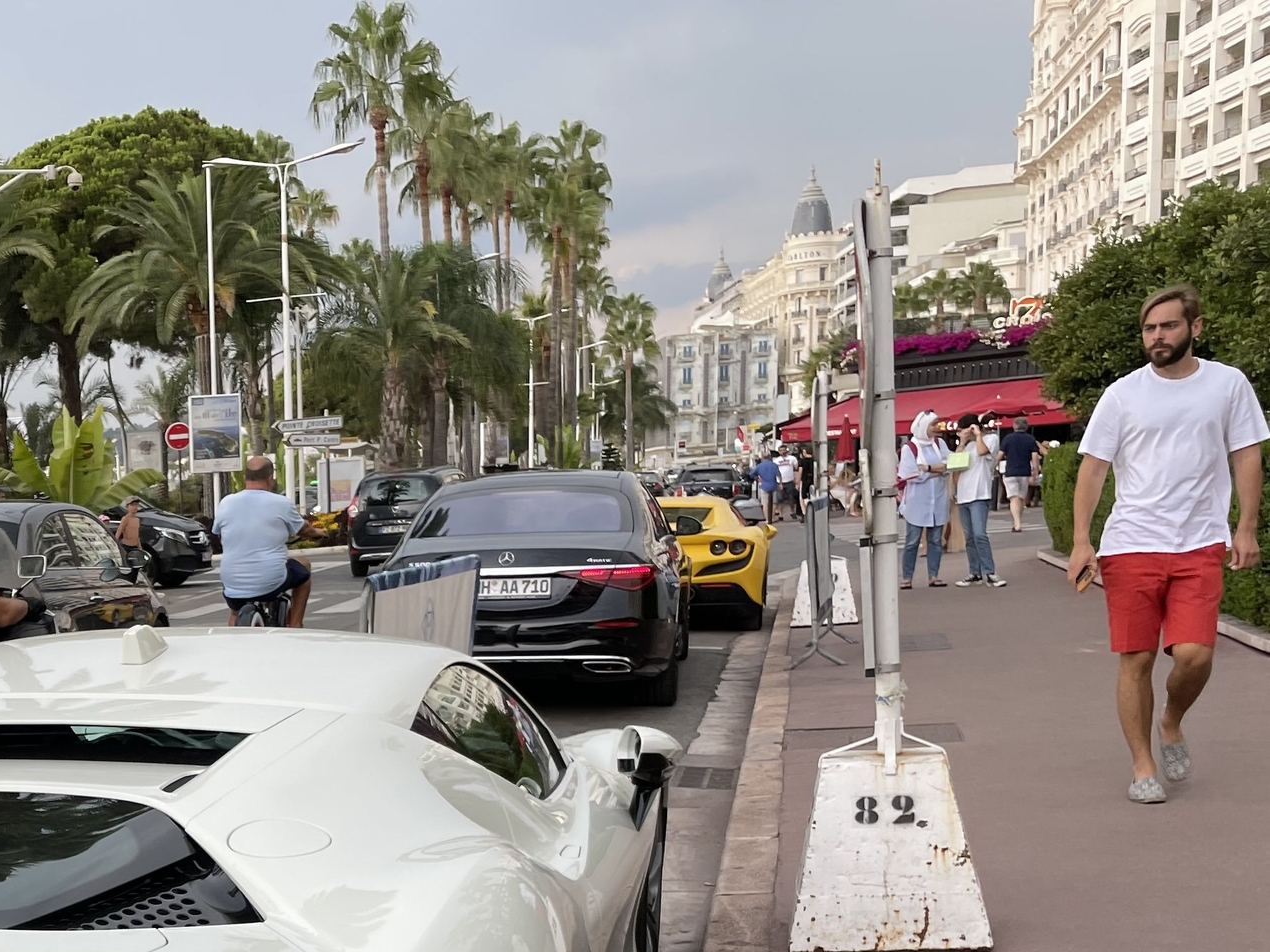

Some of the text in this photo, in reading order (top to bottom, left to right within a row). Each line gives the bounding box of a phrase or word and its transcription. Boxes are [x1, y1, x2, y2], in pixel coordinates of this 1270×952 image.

[281, 419, 340, 429] POINTE CROISETTE
[500, 580, 519, 594] AA
[521, 579, 549, 594] 710
